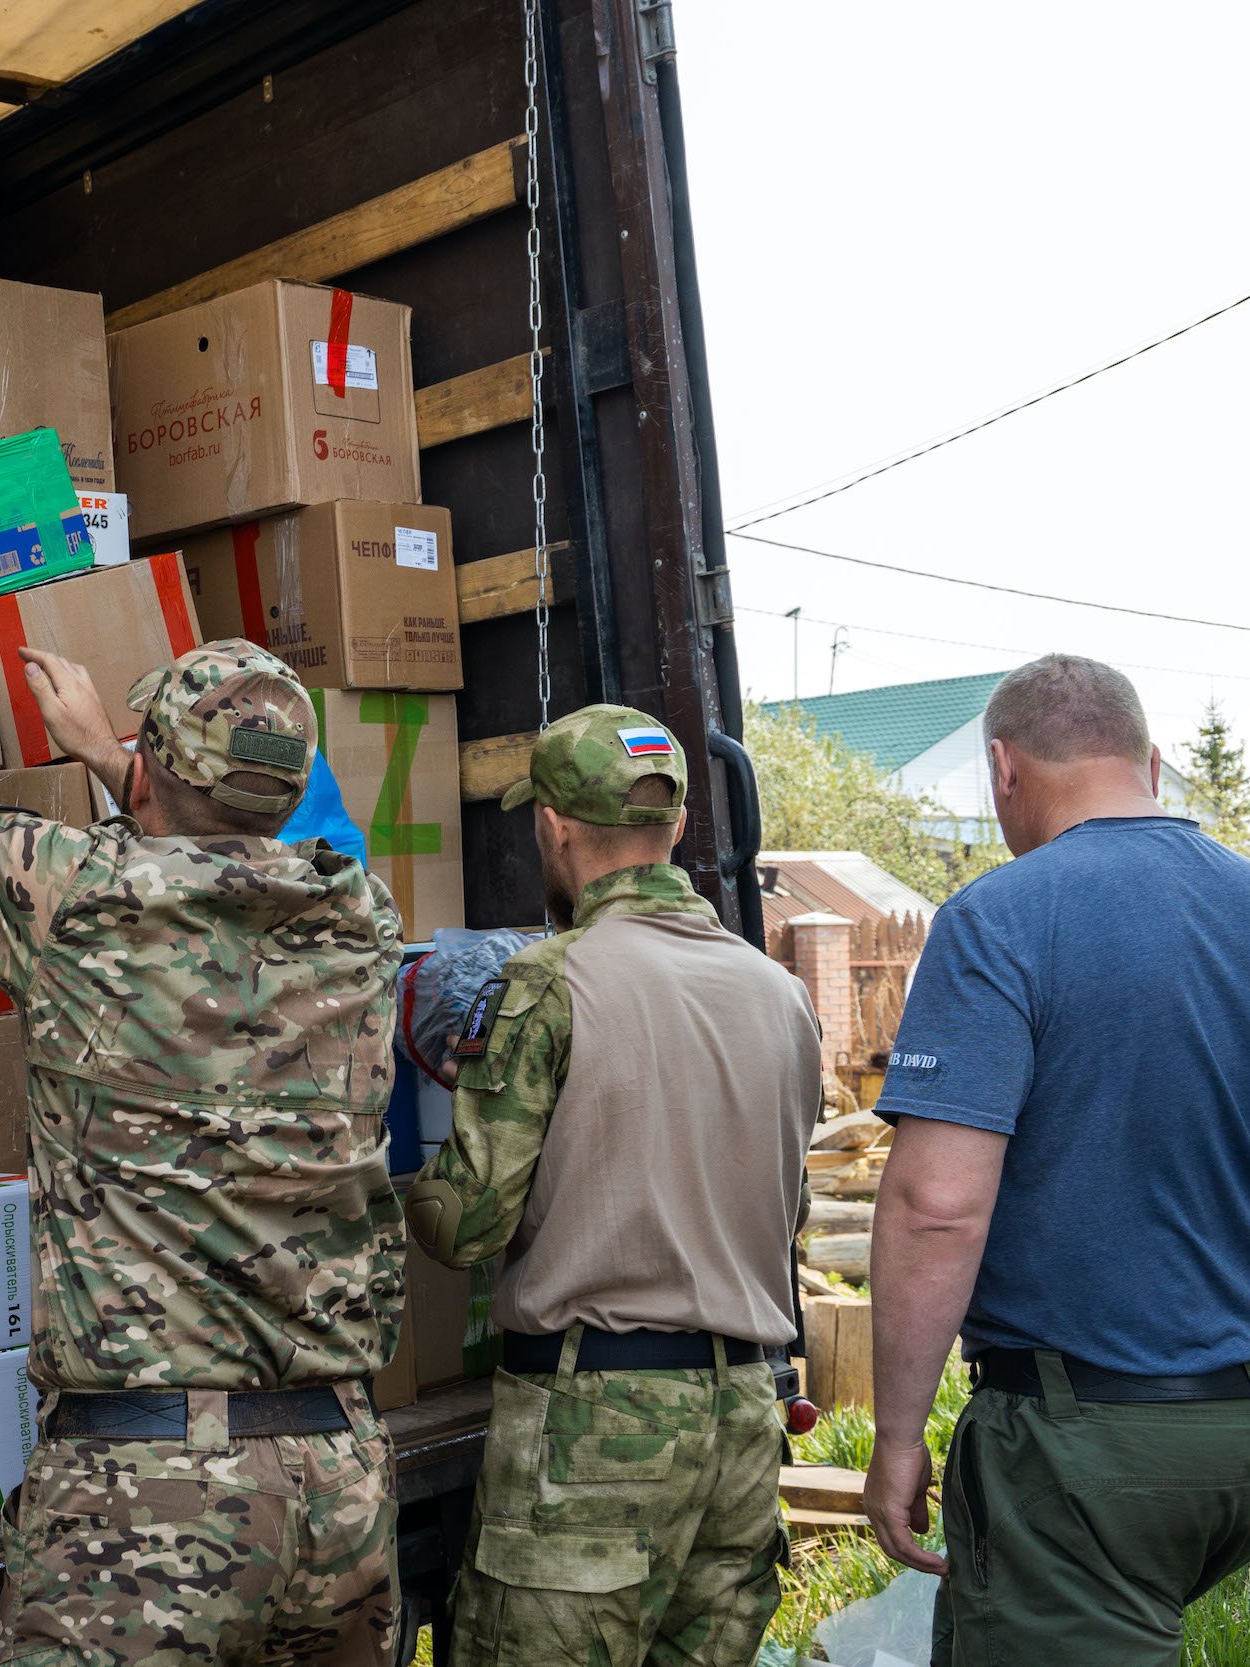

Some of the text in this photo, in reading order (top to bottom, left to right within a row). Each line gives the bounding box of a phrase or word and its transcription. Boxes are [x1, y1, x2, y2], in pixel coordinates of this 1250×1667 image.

[127, 396, 262, 454] БОРОВСКАЯ
[168, 443, 221, 467] borfab.ru
[332, 447, 392, 466] БОРОВСКАЯ
[403, 617, 417, 627] КАК
[431, 632, 454, 644] ЛУЧШЕ
[902, 1053, 938, 1069] DAVID
[3, 1203, 21, 1338] Опрыскиватель 16L
